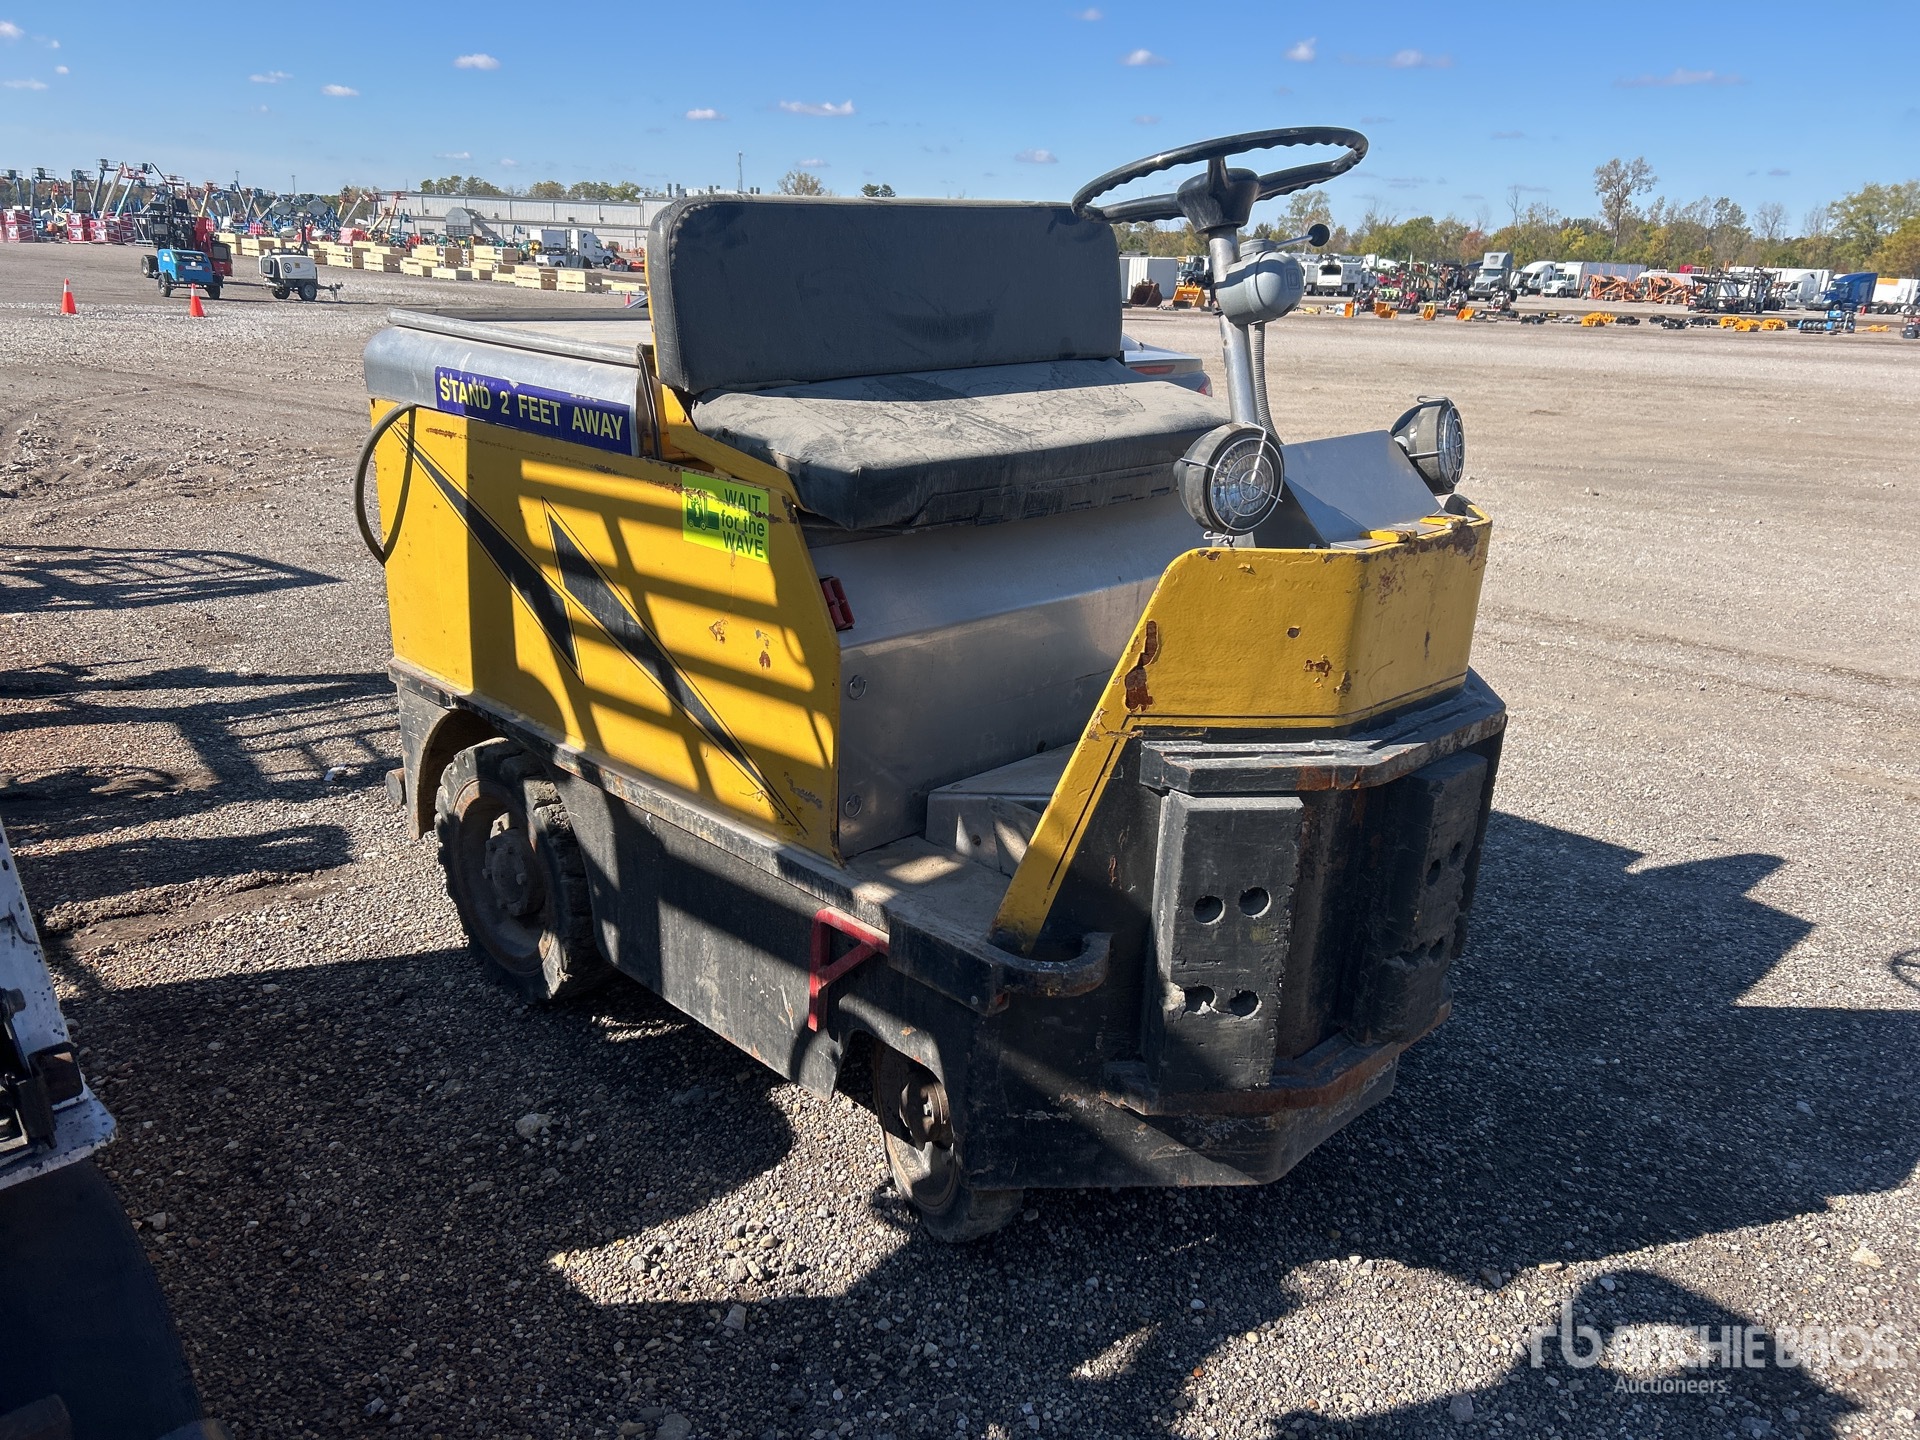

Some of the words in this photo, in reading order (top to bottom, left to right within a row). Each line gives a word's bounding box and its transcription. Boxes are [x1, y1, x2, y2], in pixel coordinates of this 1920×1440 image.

[440, 377, 491, 410] STAND
[499, 390, 510, 415] 2
[517, 393, 561, 427] FEET
[571, 406, 623, 441] AWAY
[724, 488, 761, 513] WAIT
[720, 509, 740, 531] for
[743, 516, 765, 537] the
[722, 530, 764, 559] WAVE
